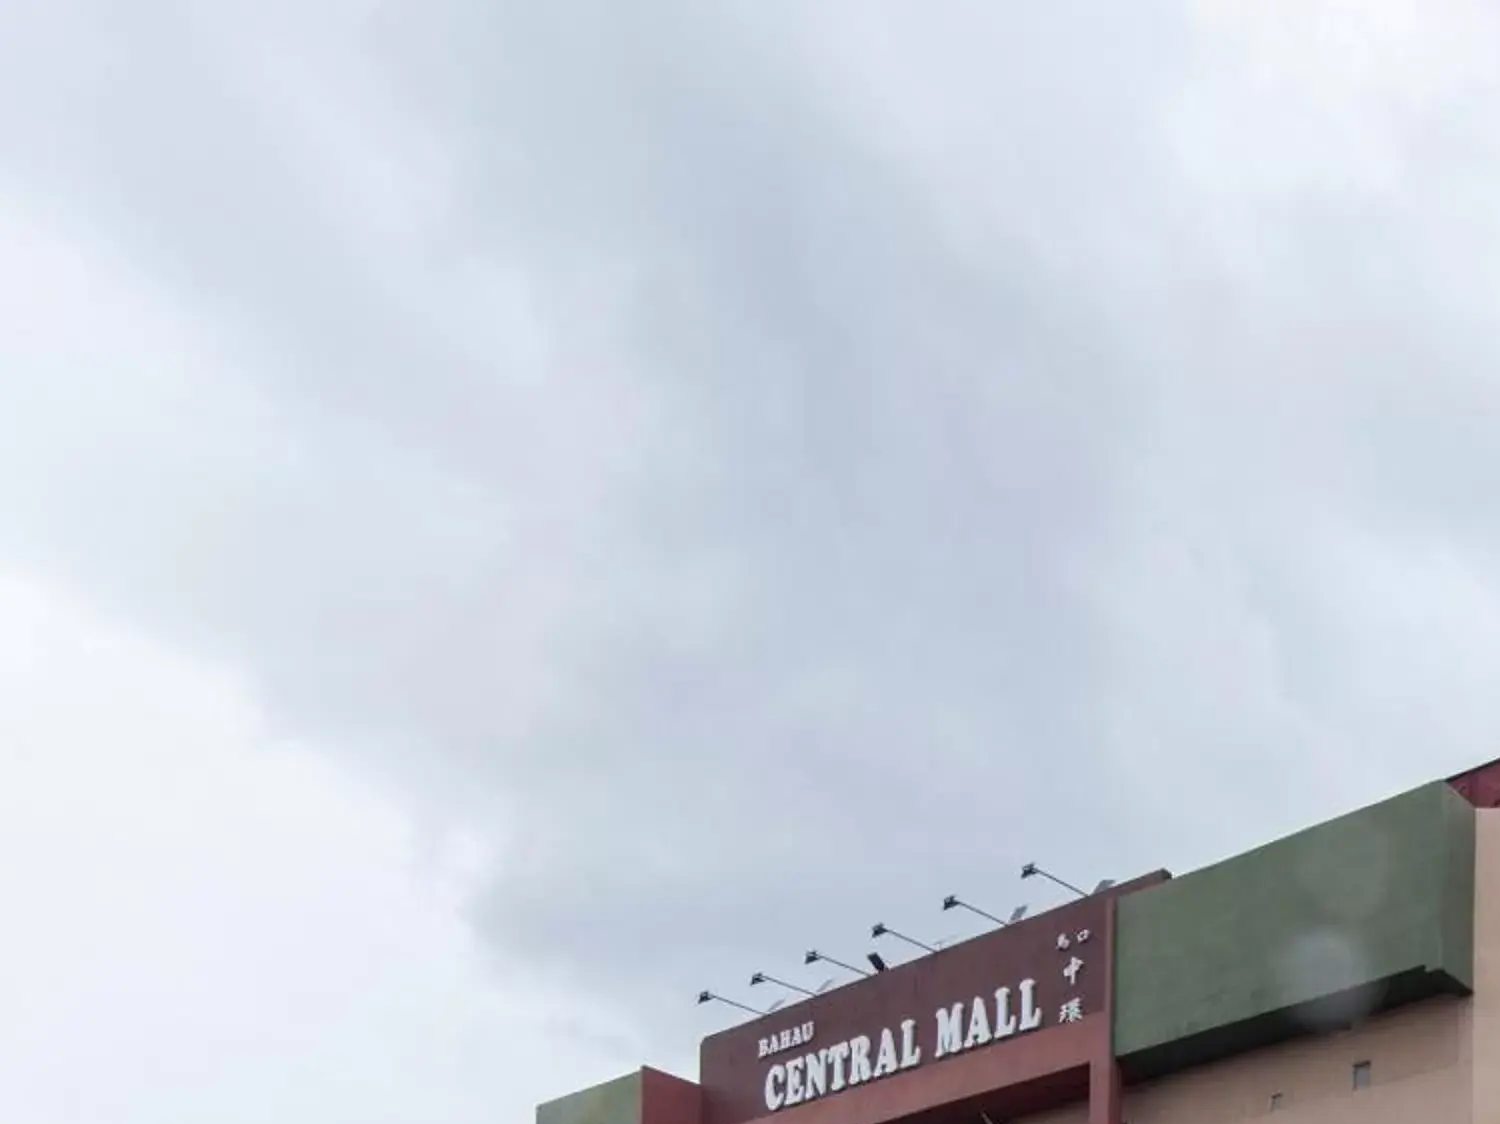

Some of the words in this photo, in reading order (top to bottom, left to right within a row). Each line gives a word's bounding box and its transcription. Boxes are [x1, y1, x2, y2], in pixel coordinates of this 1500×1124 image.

[758, 1021, 814, 1058] BAHAU
[765, 1019, 920, 1111] CENTRAL
[934, 978, 1042, 1057] MALL
